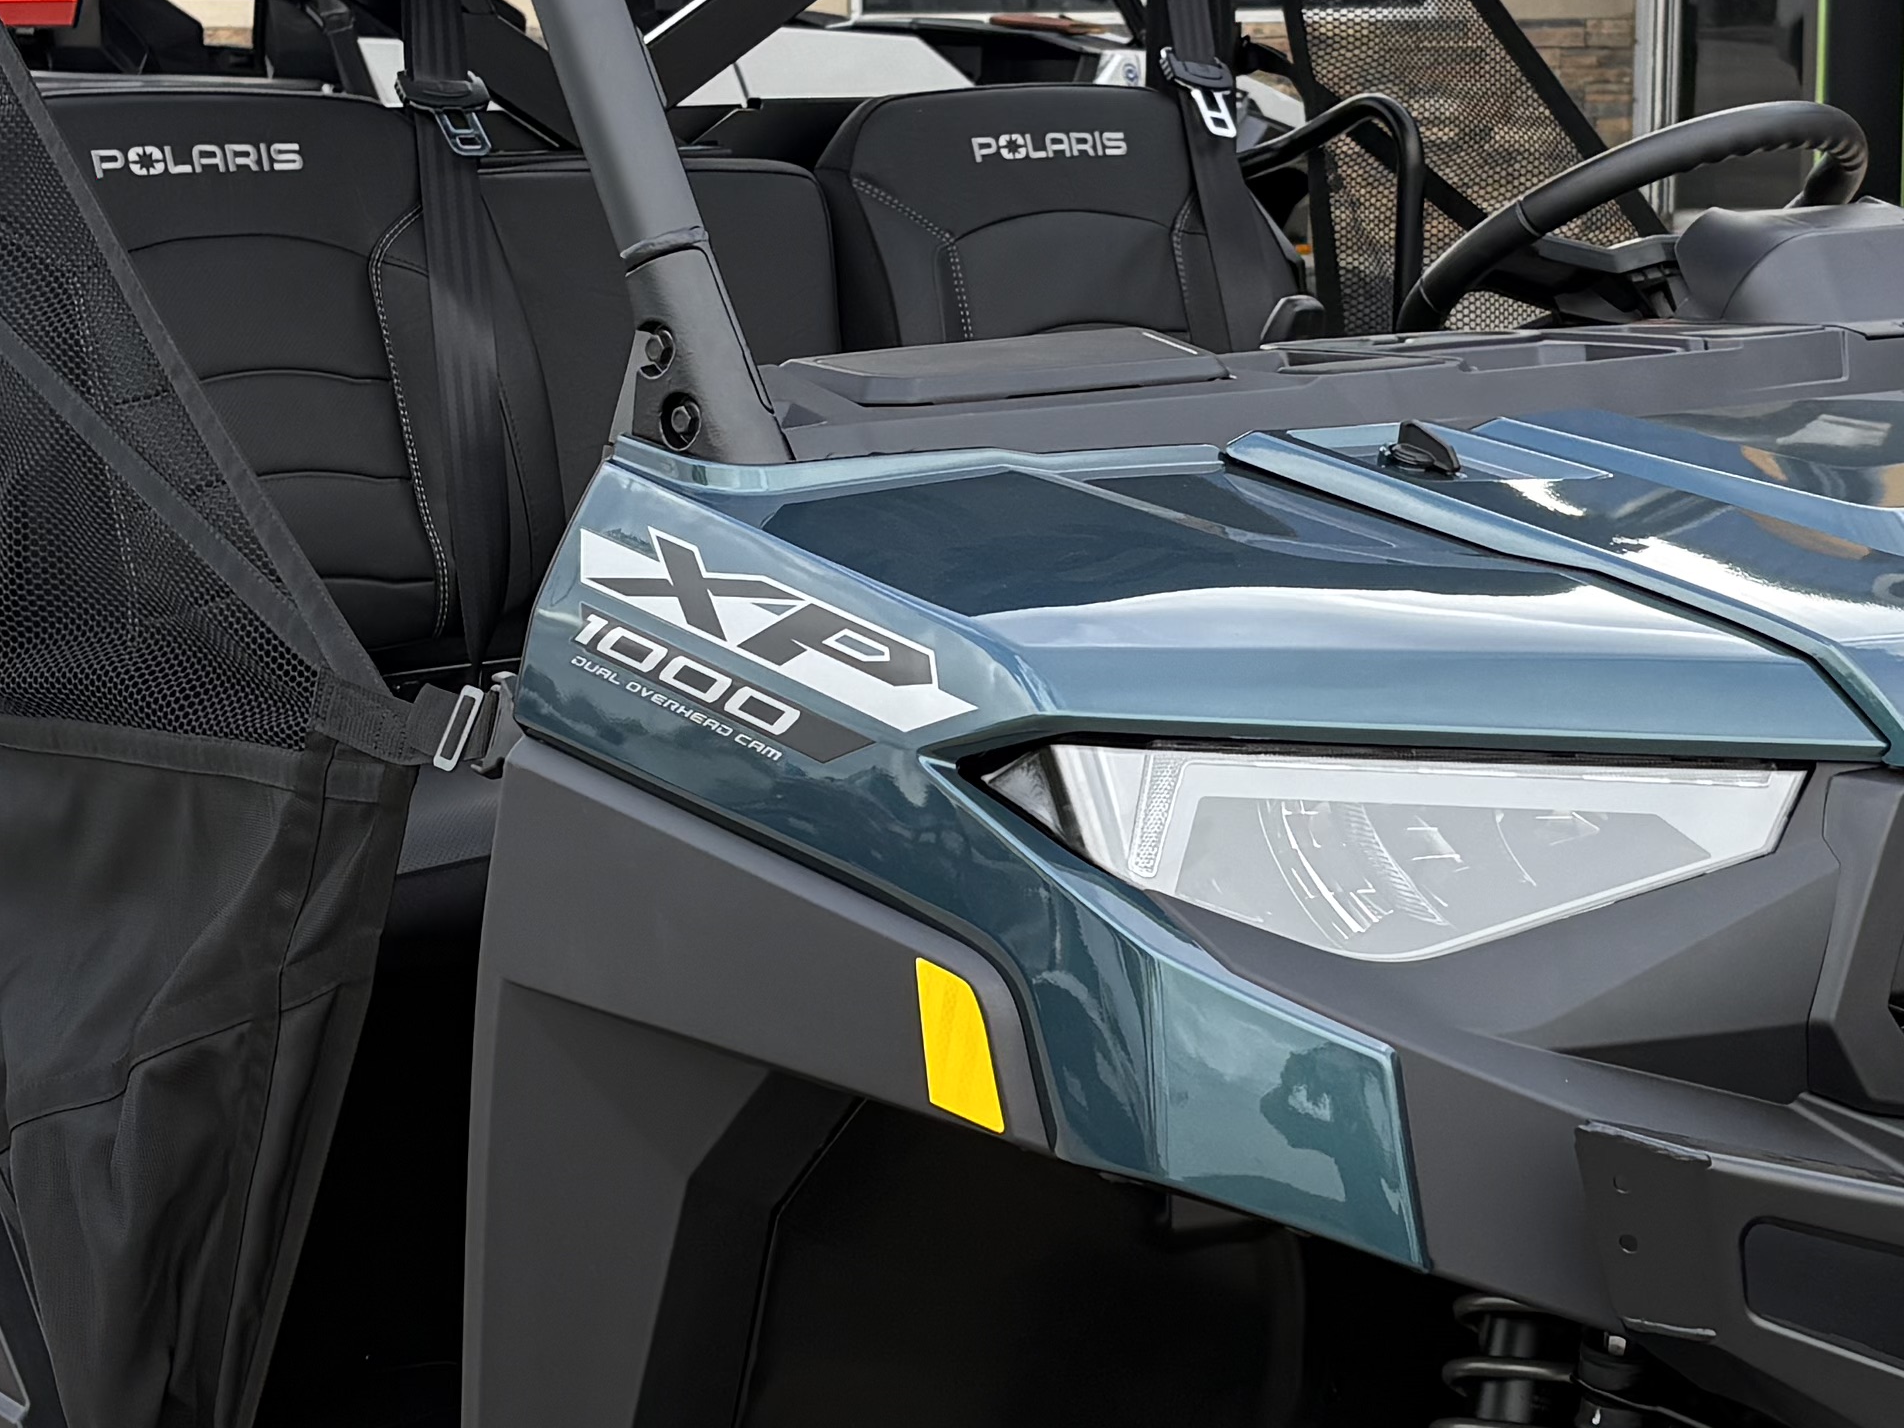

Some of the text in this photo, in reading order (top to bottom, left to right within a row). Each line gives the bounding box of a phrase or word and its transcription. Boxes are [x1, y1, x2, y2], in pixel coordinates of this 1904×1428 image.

[90, 139, 305, 179] POLARIS
[971, 129, 1128, 163] POLARIS
[583, 526, 942, 690] XP
[570, 655, 784, 763] DUAL OVERHEAD CAM
[574, 612, 802, 737] 1000
